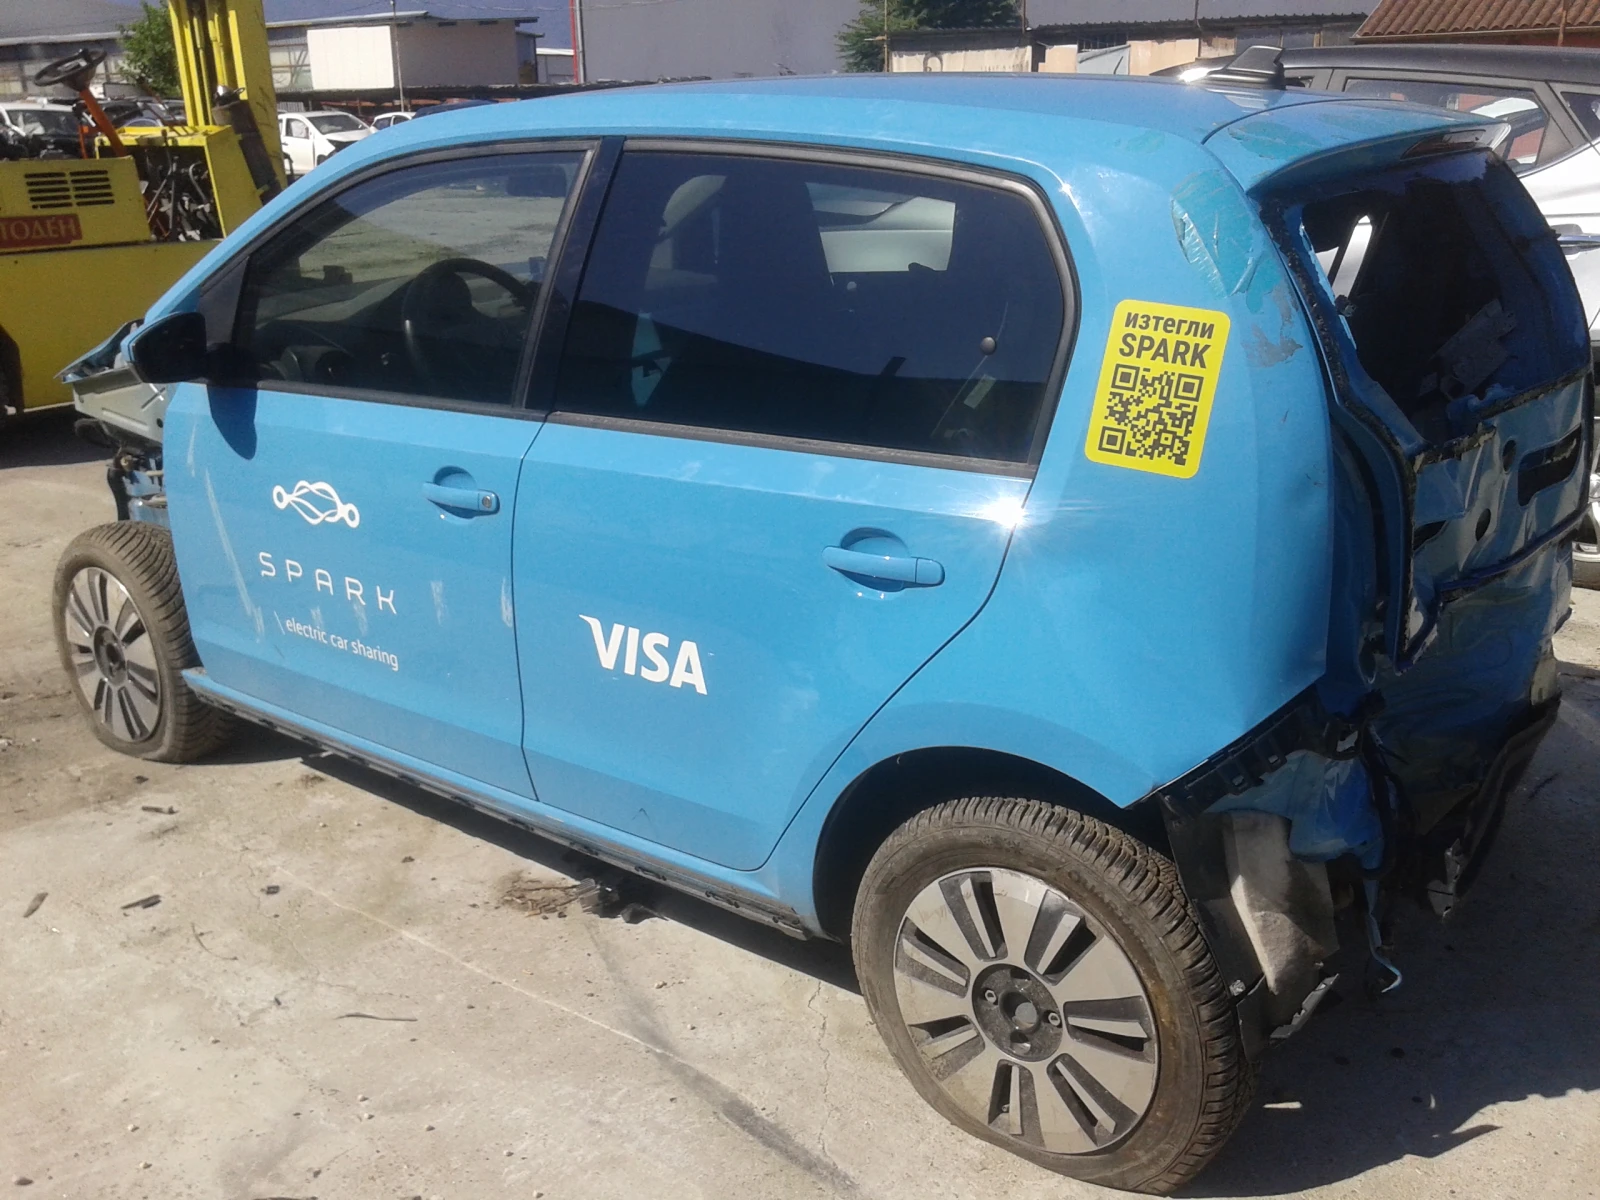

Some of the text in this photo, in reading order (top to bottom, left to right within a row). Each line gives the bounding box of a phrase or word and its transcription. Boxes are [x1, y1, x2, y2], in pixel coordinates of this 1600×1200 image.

[1118, 332, 1211, 369] SPARK
[1124, 312, 1215, 339] изтегли
[259, 551, 397, 615] SPARK
[285, 617, 399, 672] electric car sharing
[578, 614, 708, 696] VISA
